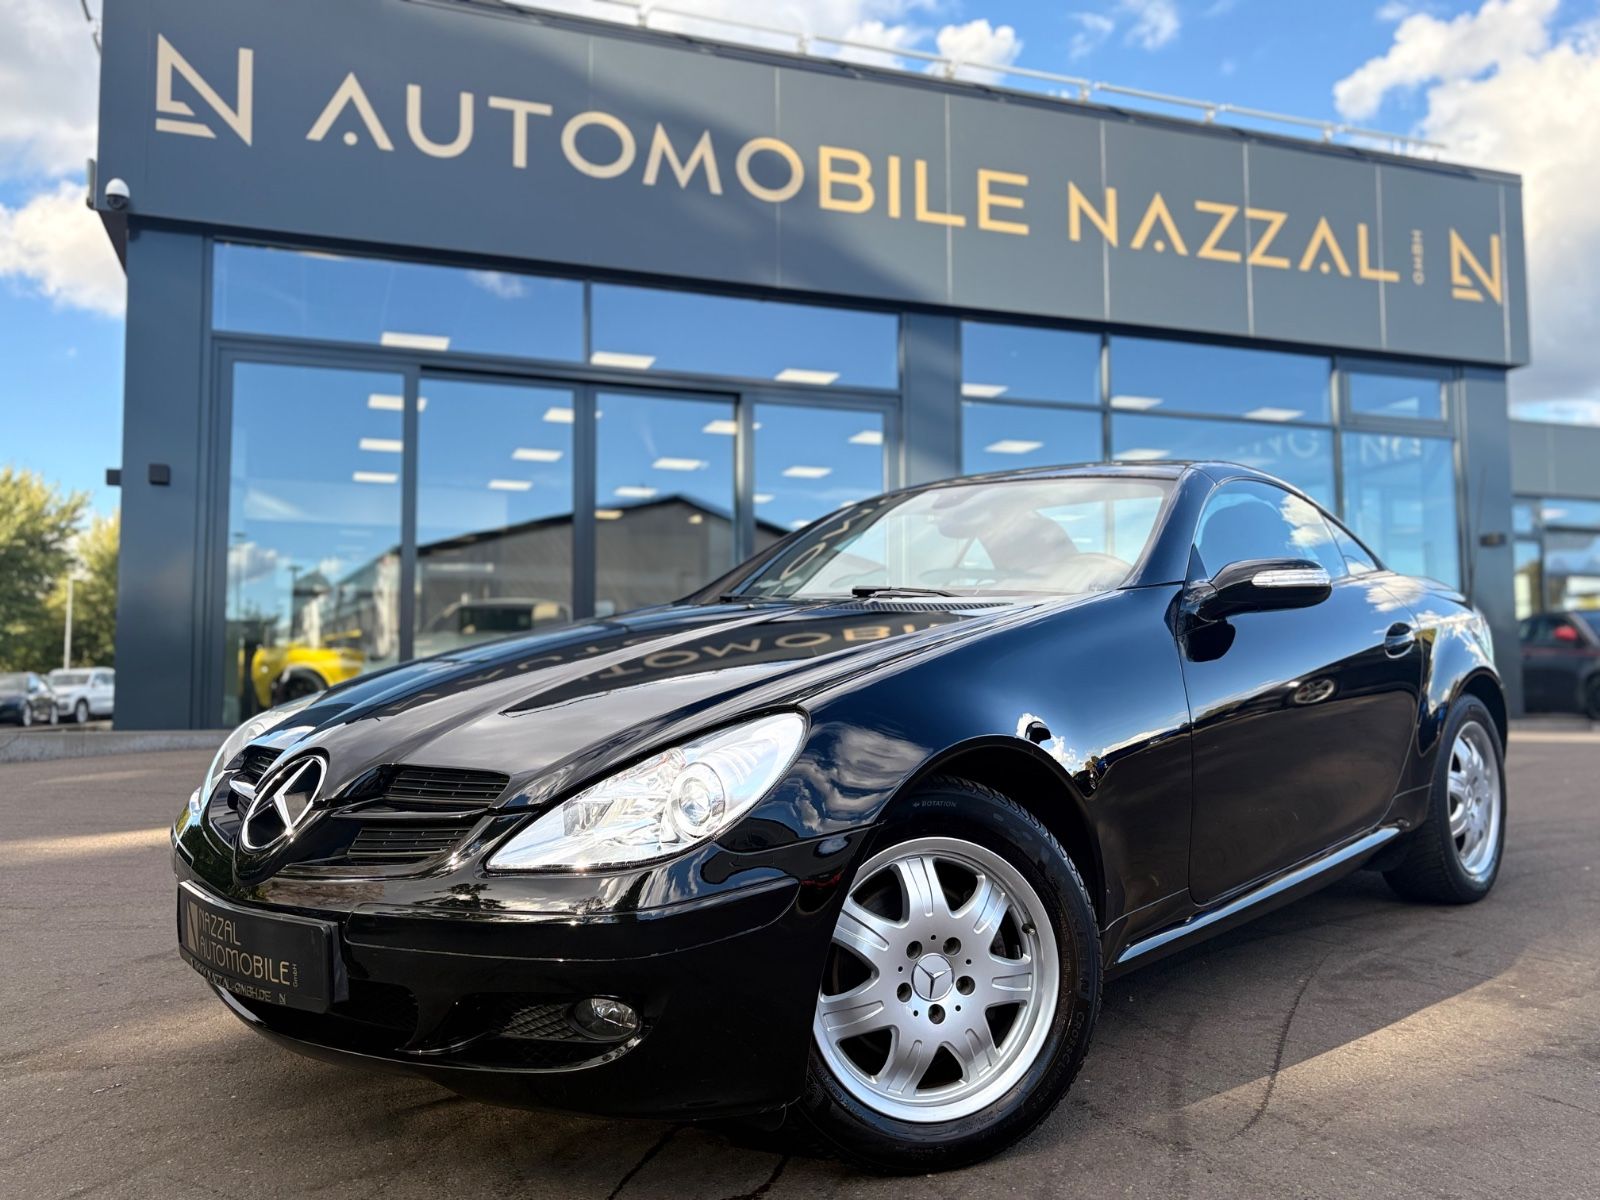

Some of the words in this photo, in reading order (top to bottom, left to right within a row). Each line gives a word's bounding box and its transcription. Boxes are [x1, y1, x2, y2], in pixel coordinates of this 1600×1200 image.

[306, 71, 1029, 236] AUTOMOBILE
[1068, 180, 1400, 283] NAZZAL
[199, 908, 242, 946] NAZZAL
[199, 935, 291, 986] AUTOMOBILE
